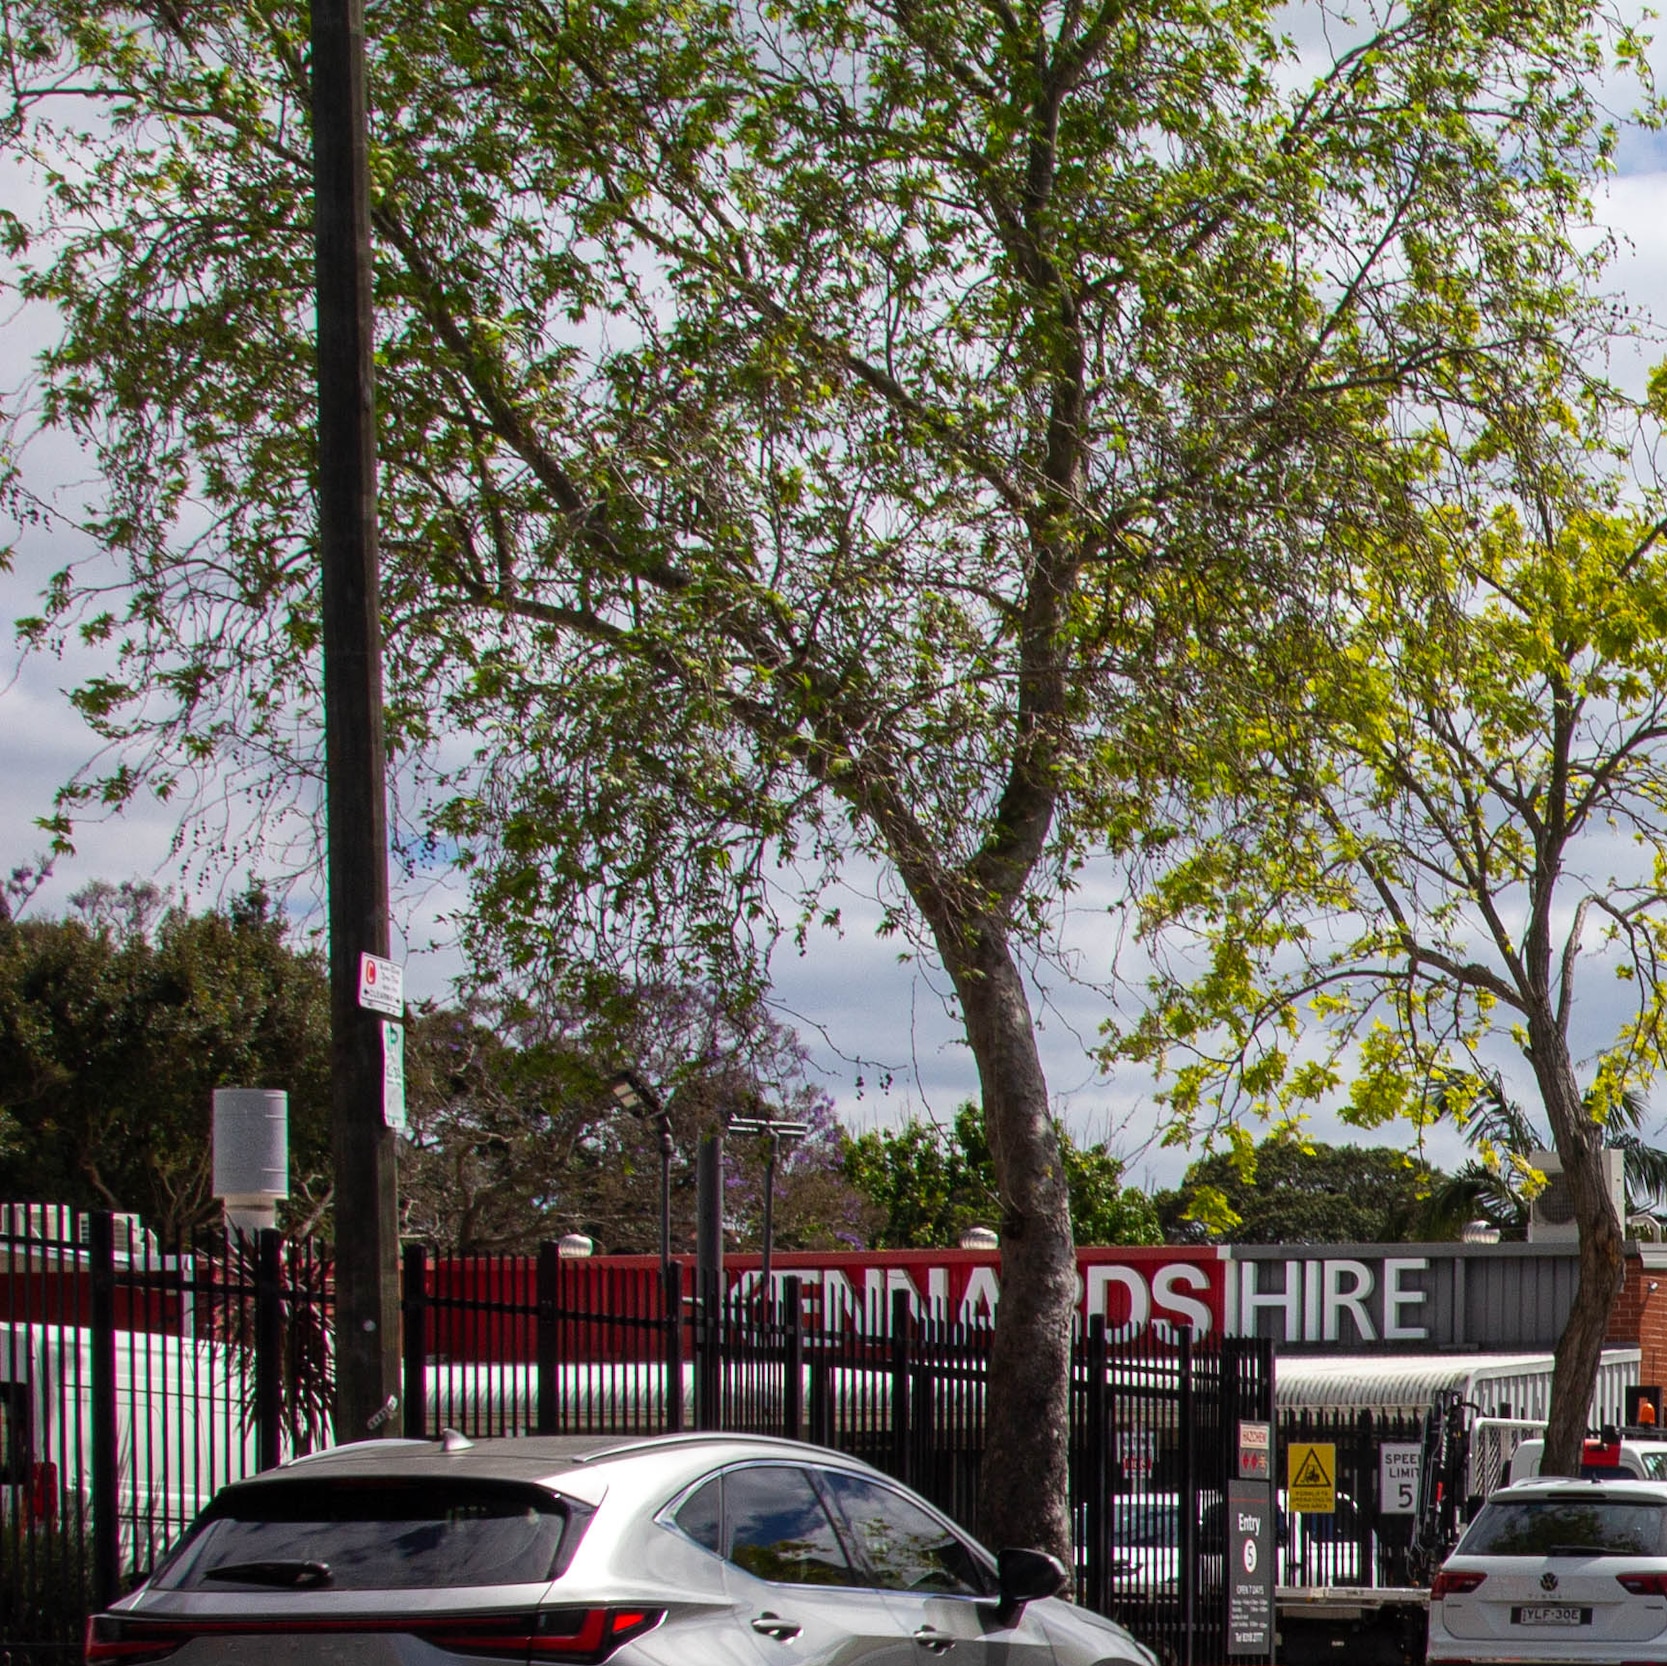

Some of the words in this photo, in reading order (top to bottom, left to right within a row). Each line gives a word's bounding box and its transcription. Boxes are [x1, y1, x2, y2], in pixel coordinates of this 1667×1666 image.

[719, 1263, 1212, 1345] ENNADS
[1241, 1257, 1430, 1342] HIRE
[1398, 1484, 1414, 1508] 5
[1238, 1512, 1261, 1537] Entry
